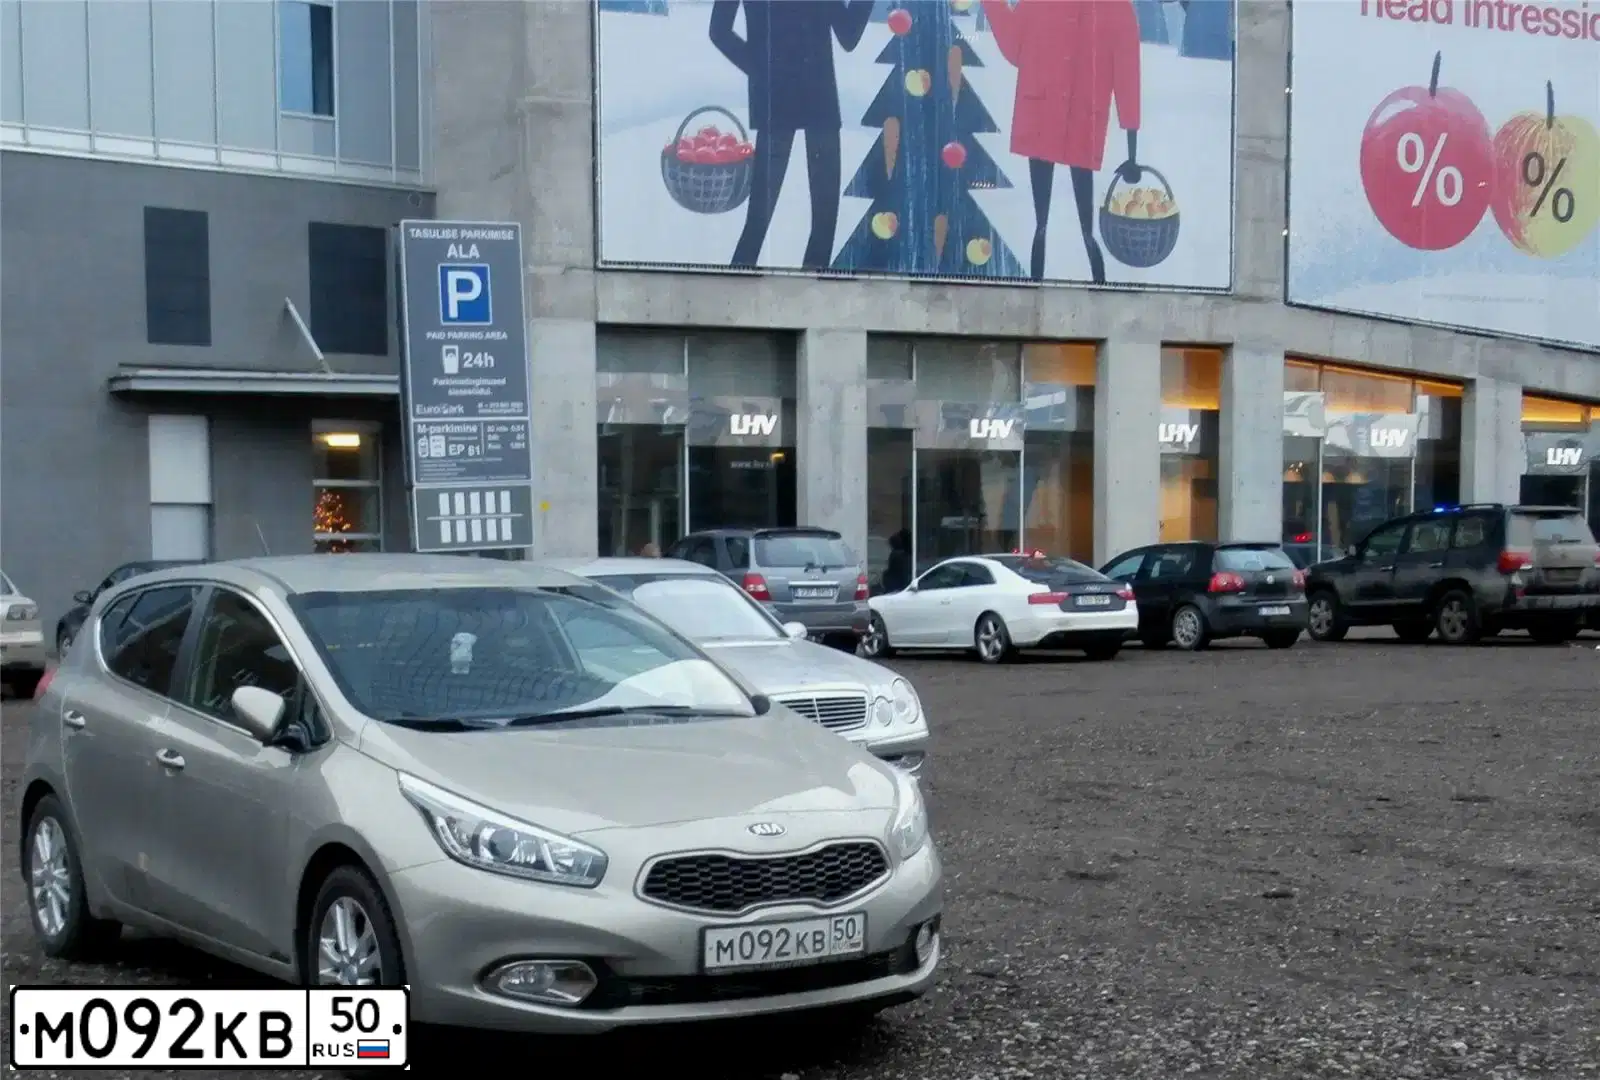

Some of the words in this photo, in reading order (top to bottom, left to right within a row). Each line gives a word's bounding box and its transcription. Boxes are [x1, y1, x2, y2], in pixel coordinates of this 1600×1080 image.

[409, 228, 458, 239] TASULISE
[460, 229, 514, 240] PARKIMISE
[447, 243, 480, 259] ALA
[447, 271, 482, 319] P
[426, 332, 445, 340] PAID
[447, 332, 483, 340] PARKING
[484, 332, 508, 340] AREA
[463, 352, 494, 368] 24h
[730, 414, 777, 435] LHV
[969, 418, 1014, 439] LHV
[1158, 423, 1199, 444] LHV
[1370, 428, 1407, 448] LHV
[449, 444, 465, 457] EP
[1547, 447, 1582, 466] LHV
[834, 917, 856, 941] 50
